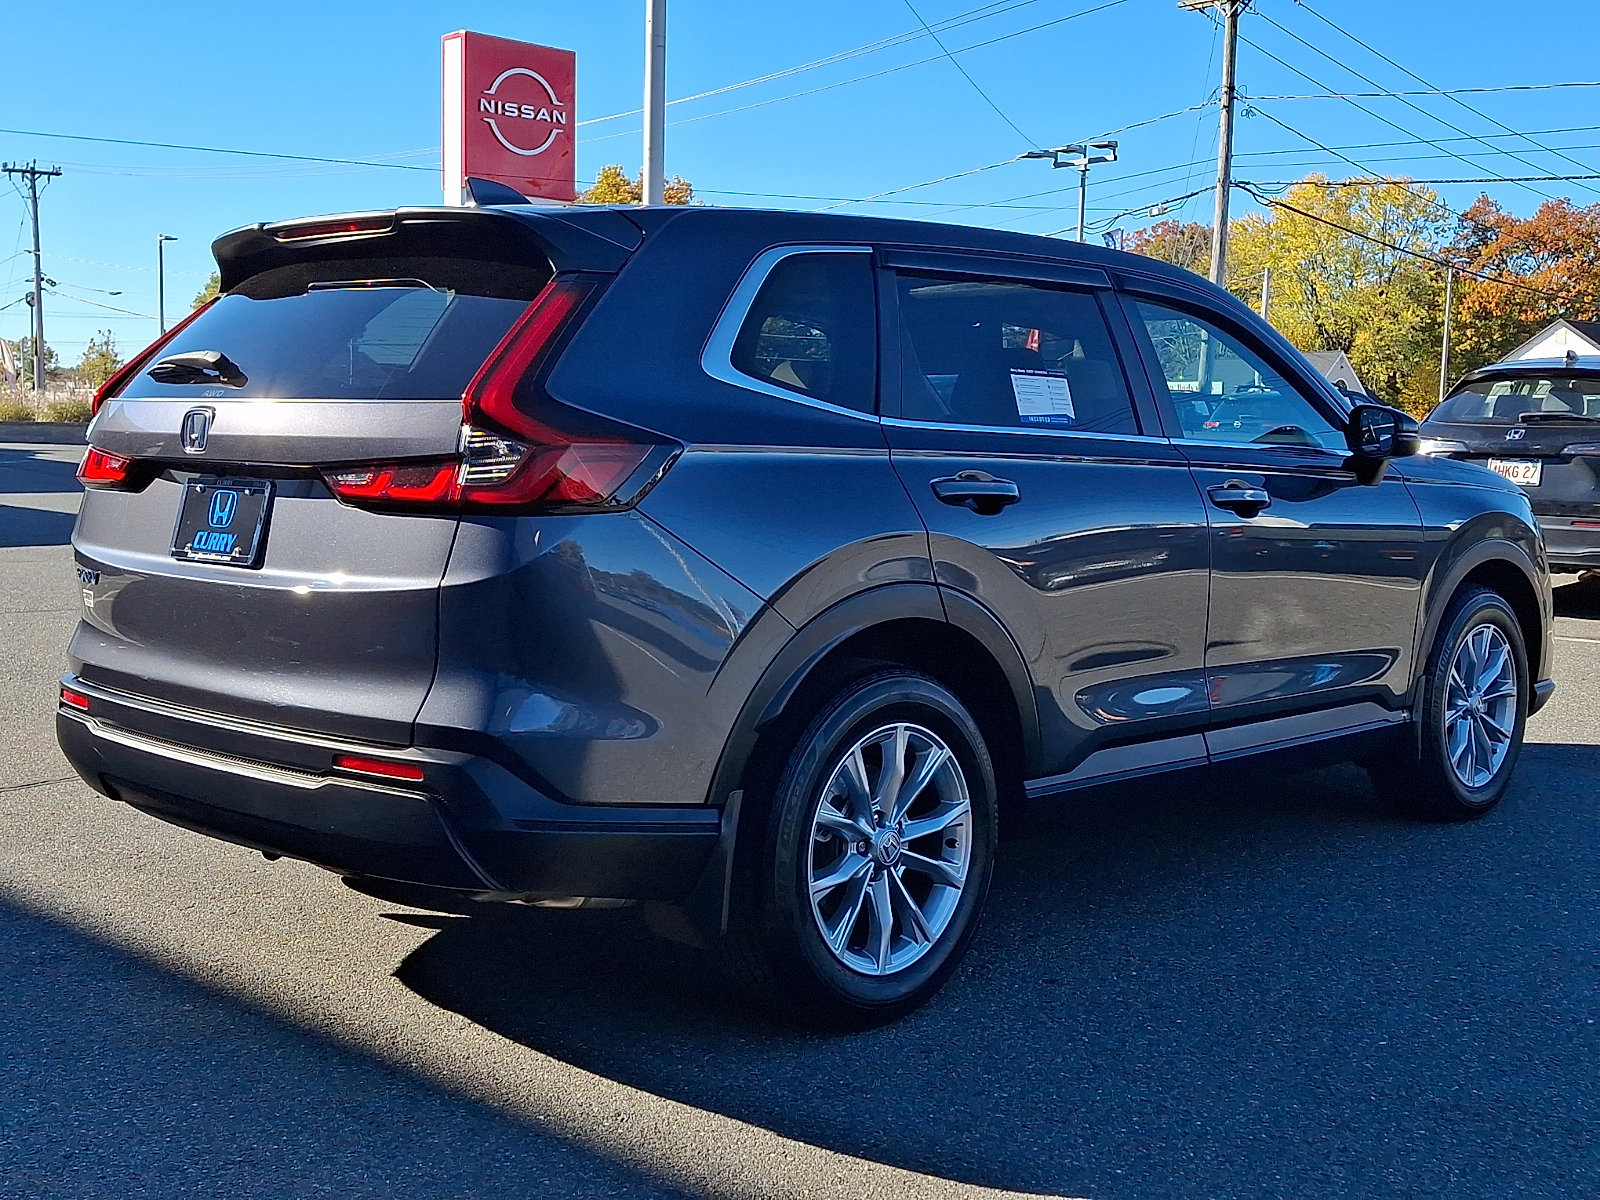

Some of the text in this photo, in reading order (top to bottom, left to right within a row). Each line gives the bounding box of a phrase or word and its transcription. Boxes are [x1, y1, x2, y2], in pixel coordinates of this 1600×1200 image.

[480, 98, 566, 124] NISSAN
[1523, 465, 1538, 479] 27
[193, 531, 238, 552] CURRY
